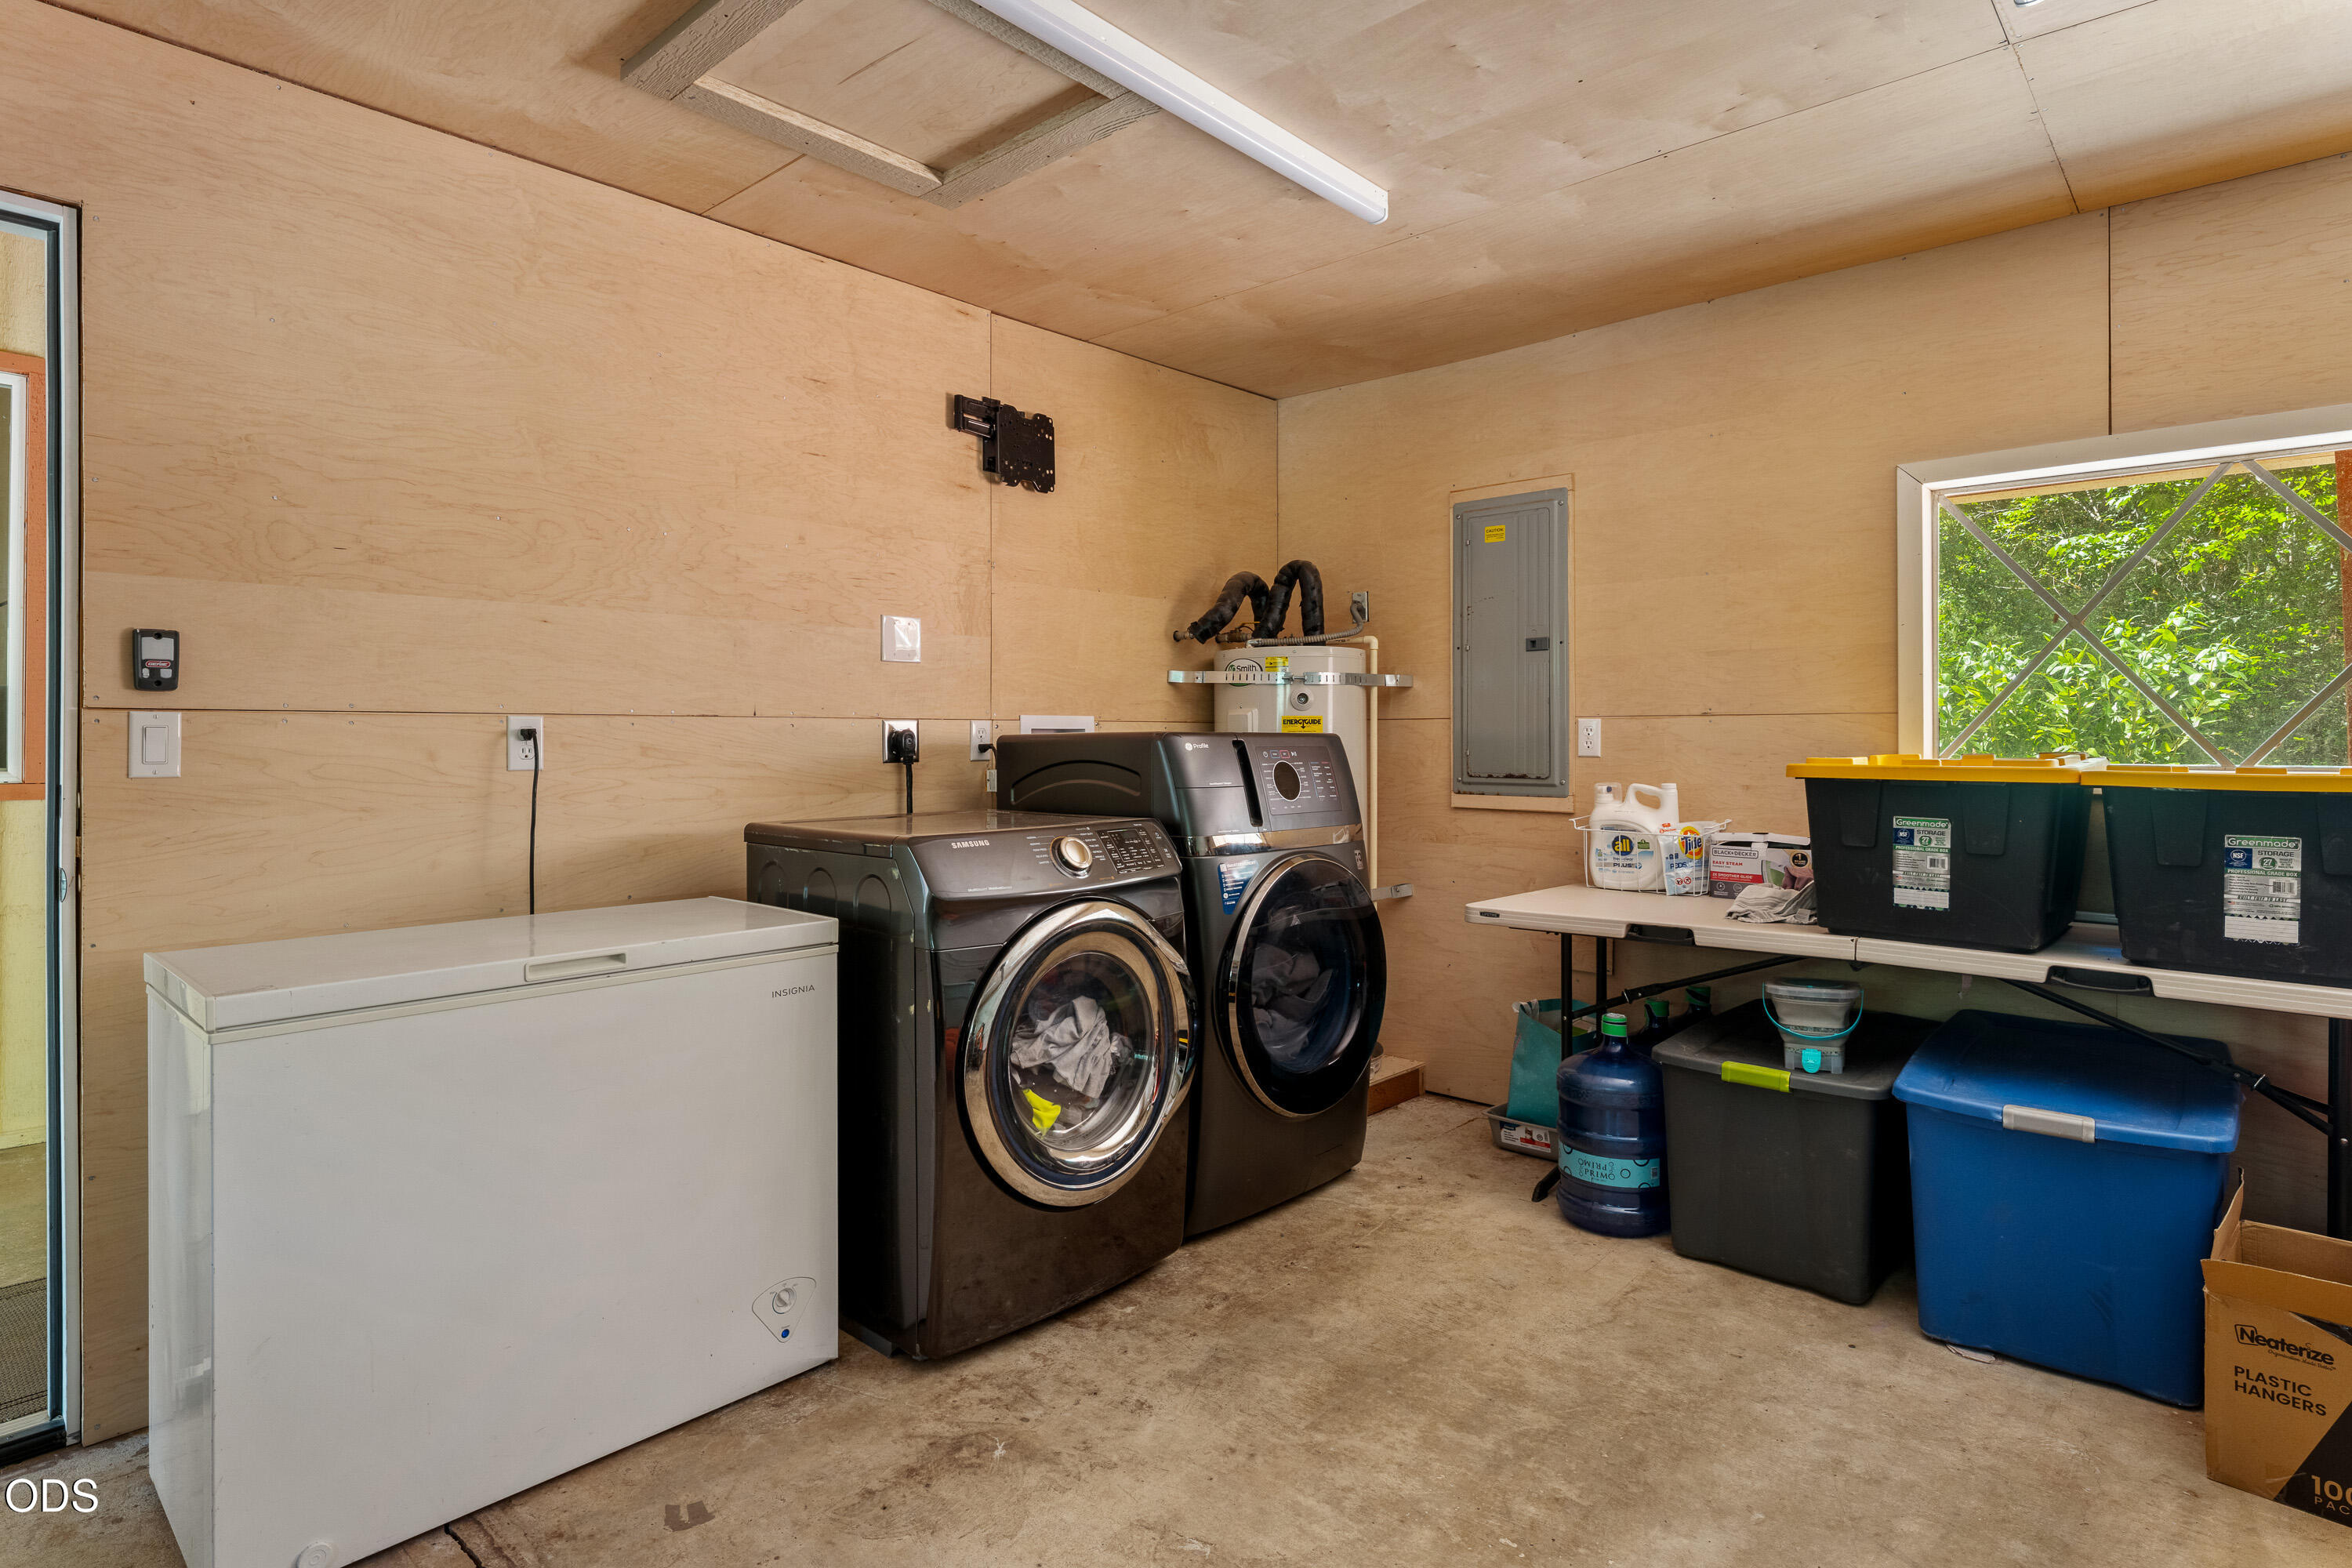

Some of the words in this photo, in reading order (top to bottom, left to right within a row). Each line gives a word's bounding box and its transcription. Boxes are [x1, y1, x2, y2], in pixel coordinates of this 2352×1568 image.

[1896, 818, 1947, 828] Greenmade
[951, 840, 990, 849] SAMSUNG
[1614, 839, 1631, 851] all
[2228, 837, 2296, 848] Greenmade
[2263, 858, 2273, 866] 27
[771, 985, 815, 998] INSIGNIA
[2240, 1327, 2335, 1366] Neaterize
[2234, 1365, 2312, 1397] PLASTIC
[2234, 1380, 2327, 1417] HANGERS
